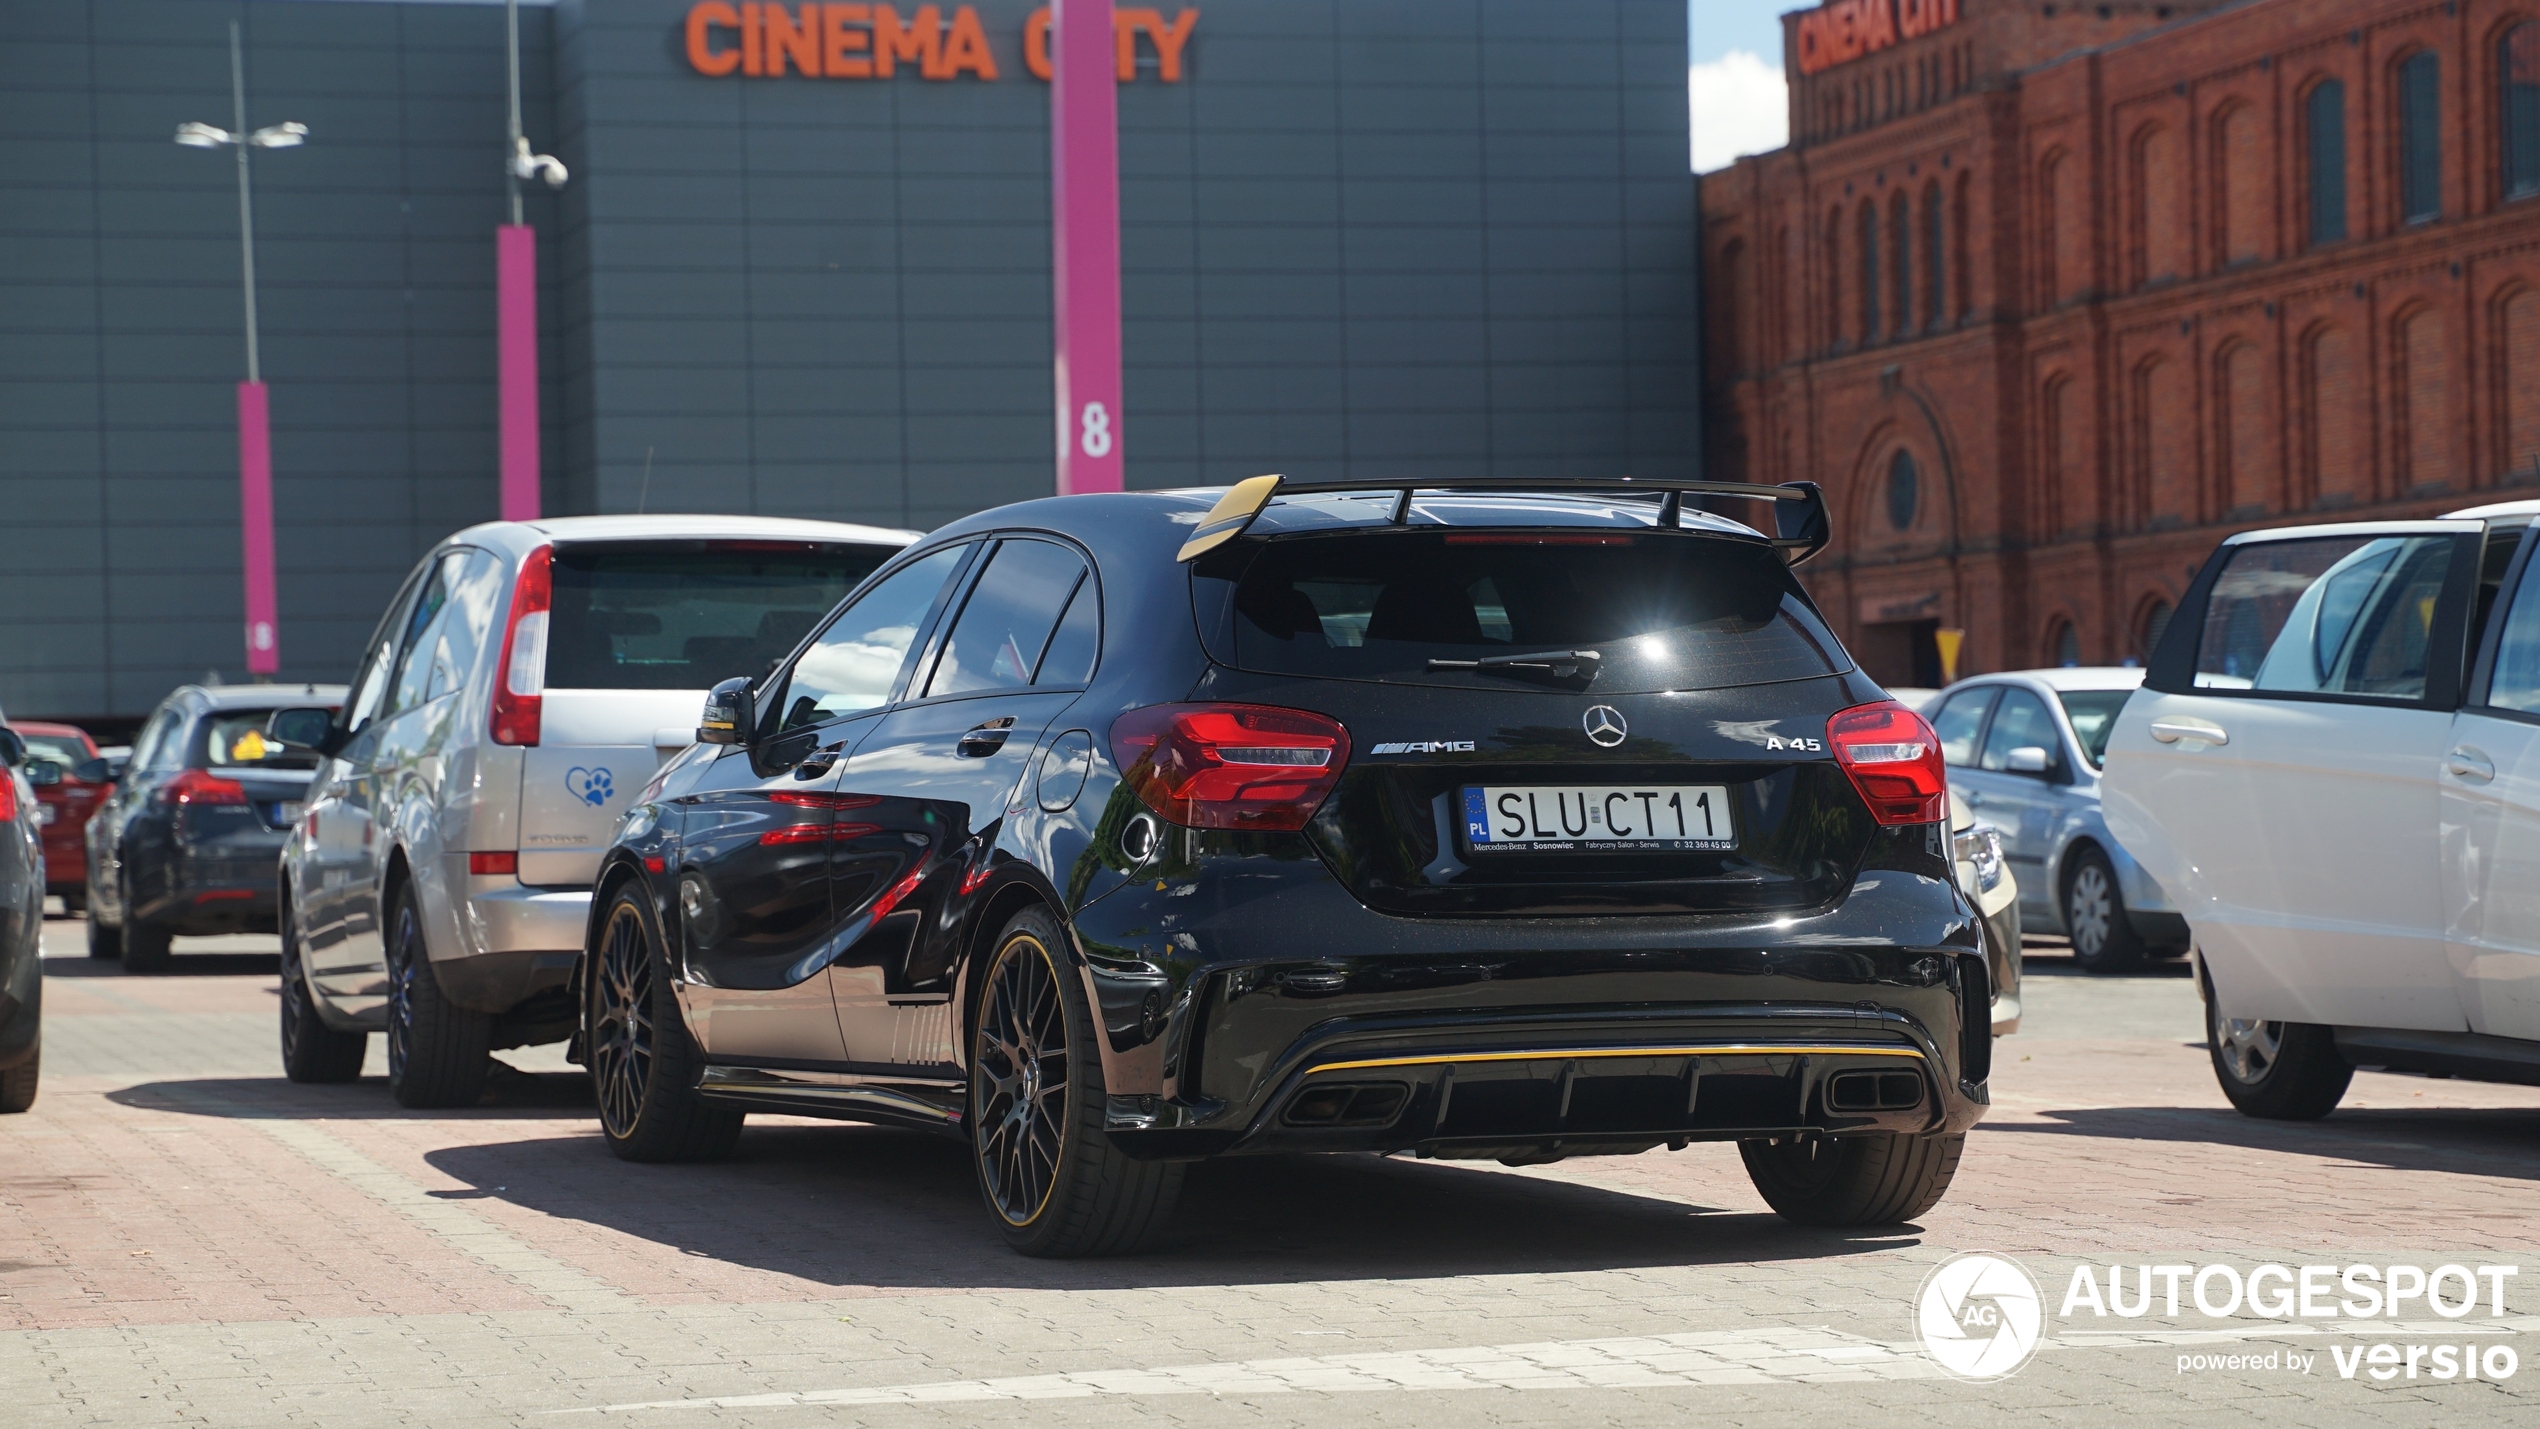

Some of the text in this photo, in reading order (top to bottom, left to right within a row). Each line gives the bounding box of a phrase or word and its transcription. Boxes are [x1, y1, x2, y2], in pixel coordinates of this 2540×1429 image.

[686, 1, 1198, 82] CINEMA CTY
[1081, 401, 1112, 458] 8
[1404, 741, 1475, 754] AMG
[1766, 737, 1821, 752] A 45
[1497, 791, 1714, 838] SLU CT11
[1469, 823, 1487, 836] PL
[1474, 842, 1527, 851] Mercedes-Benz
[1533, 841, 1574, 850] Sosnowiec
[1585, 841, 1616, 850] Fabryczny
[1617, 841, 1635, 849] Salon
[1639, 841, 1660, 849] Serwis
[1684, 841, 1694, 849] 32
[1695, 841, 1709, 849] 368
[1710, 841, 1720, 849] 45
[1721, 841, 1731, 849] 00
